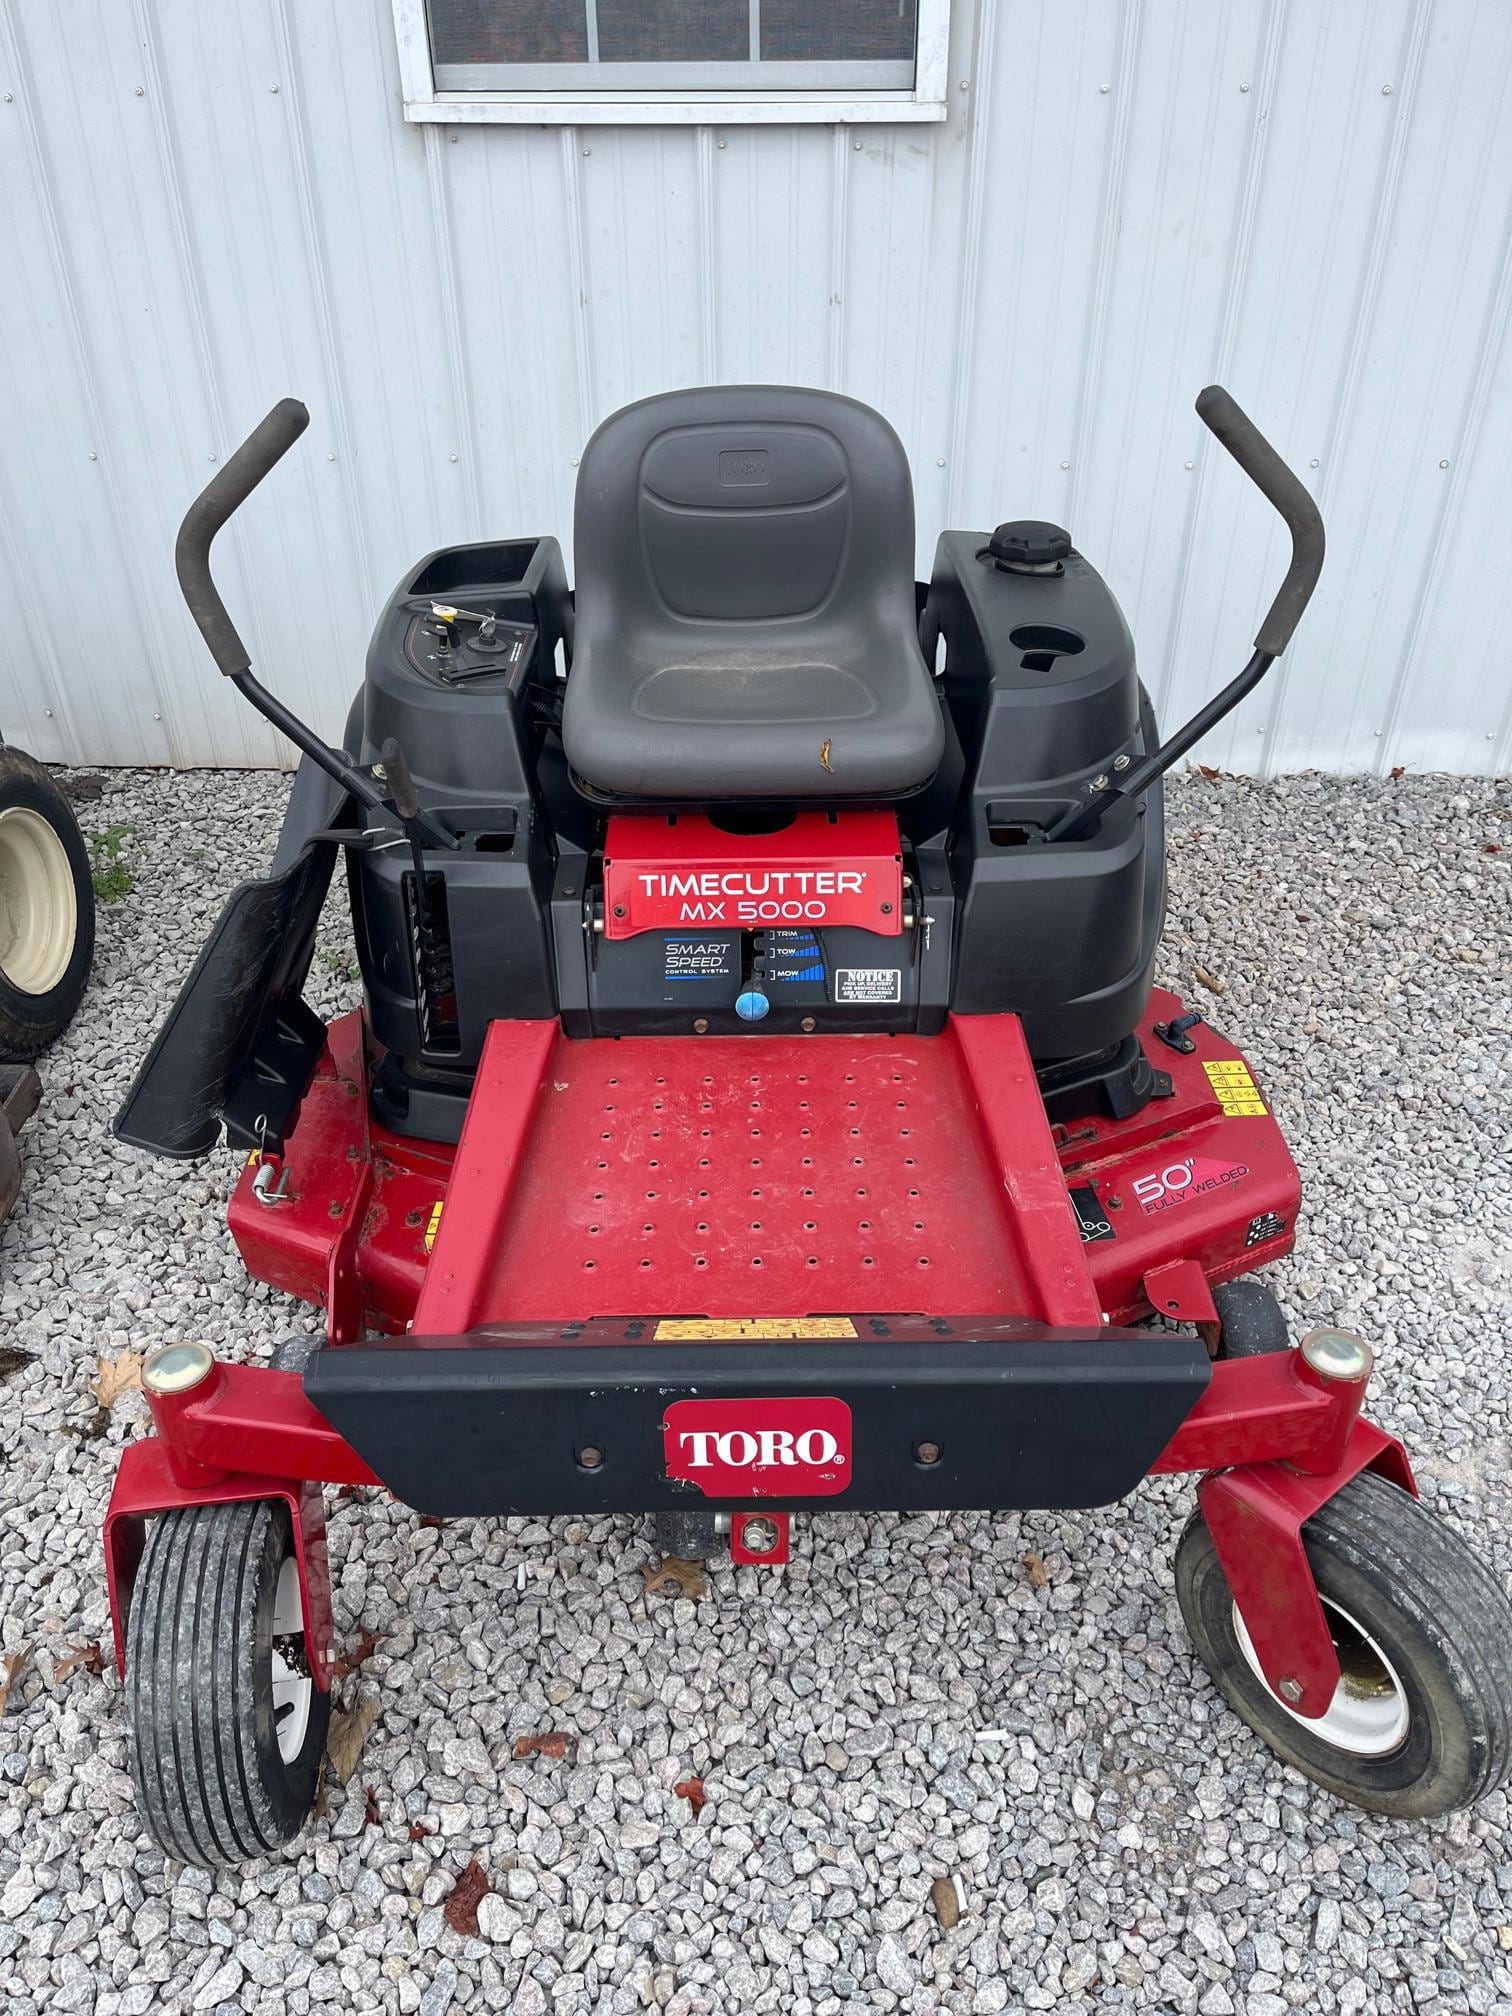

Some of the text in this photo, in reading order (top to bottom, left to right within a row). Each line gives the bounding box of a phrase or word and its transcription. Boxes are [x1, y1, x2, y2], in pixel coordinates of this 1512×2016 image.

[638, 872, 863, 896] TIMECUTTER
[679, 900, 826, 920] MX 5000
[665, 944, 731, 955] SMART
[665, 956, 723, 968] SPEED
[848, 971, 894, 982] NOTICE
[1144, 1166, 1248, 1214] FULLY WELDED
[679, 1429, 838, 1467] TORO
